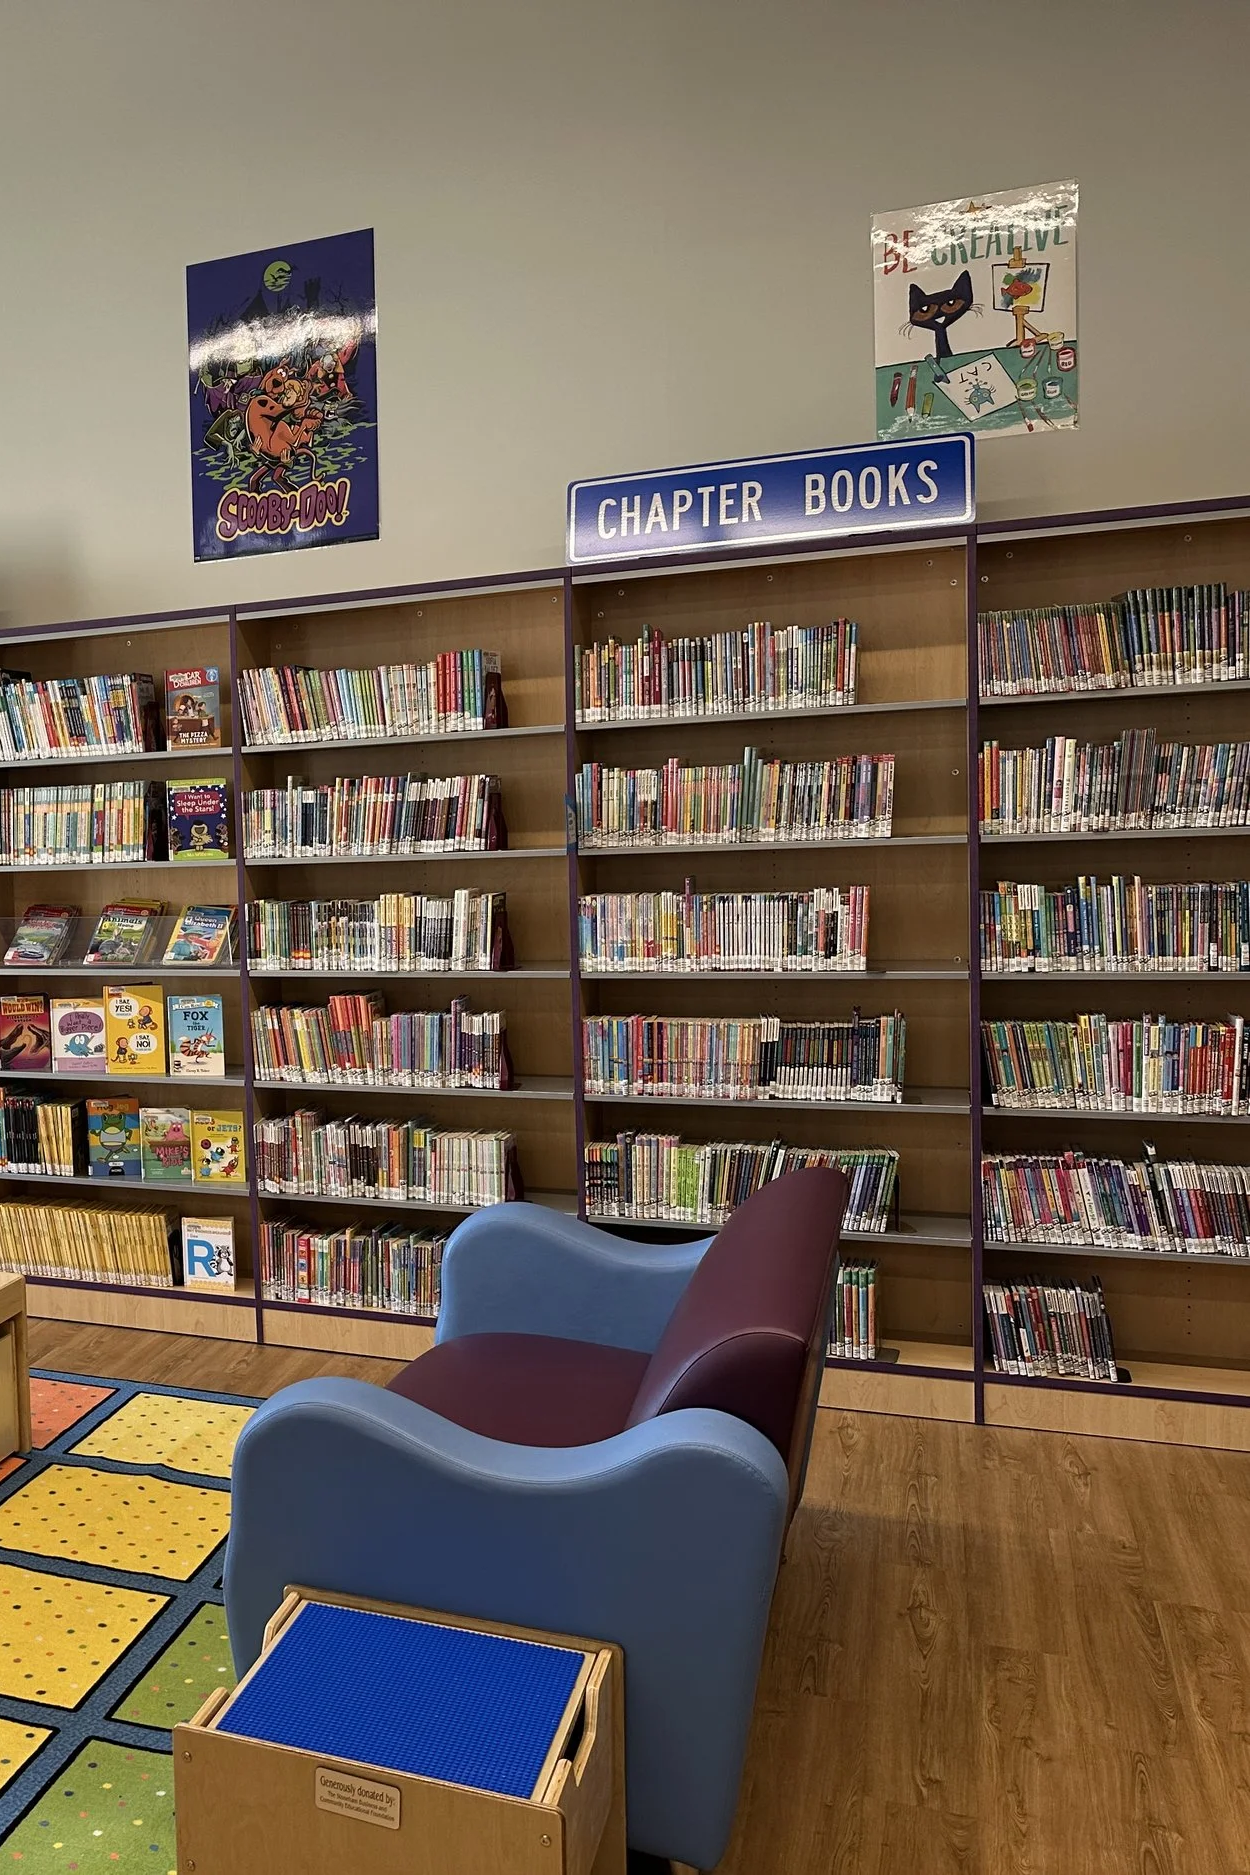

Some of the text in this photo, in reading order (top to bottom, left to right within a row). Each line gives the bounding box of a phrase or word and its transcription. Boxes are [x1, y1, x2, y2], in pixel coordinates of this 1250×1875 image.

[597, 459, 939, 540] CHAPTER BOOKS
[2, 1003, 25, 1014] WOULD
[183, 1011, 209, 1020] FOX
[187, 1239, 216, 1277] R
[319, 1776, 356, 1796] Generously
[357, 1786, 384, 1802] donated
